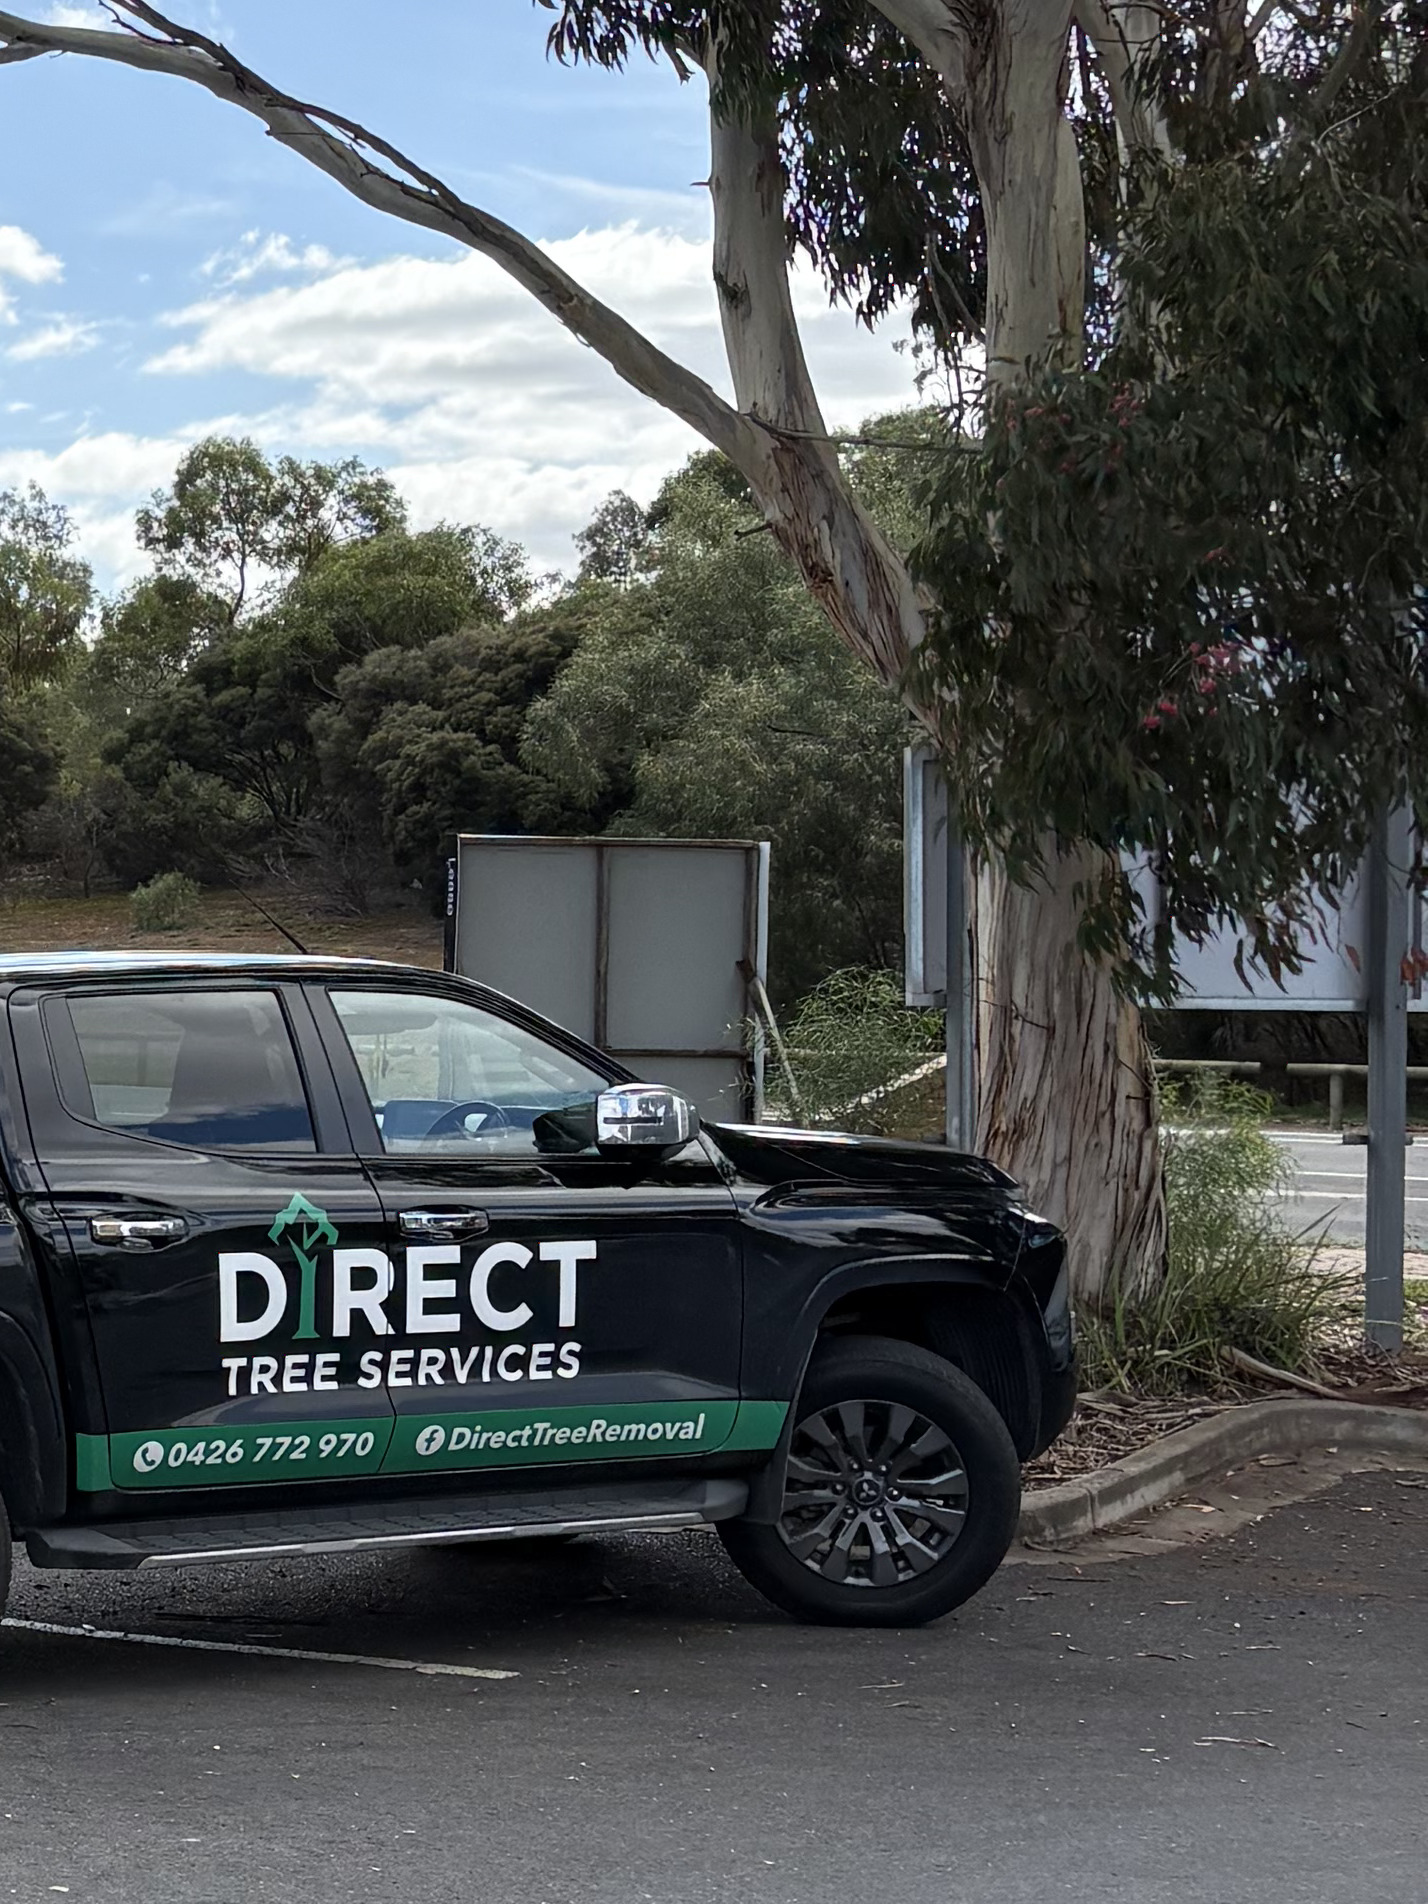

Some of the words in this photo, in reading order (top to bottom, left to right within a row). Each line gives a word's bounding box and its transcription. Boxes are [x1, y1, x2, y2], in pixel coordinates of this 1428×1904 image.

[217, 1238, 598, 1344] DIRECT
[220, 1351, 342, 1396] TREE
[356, 1340, 583, 1390] SERVICES
[167, 1438, 245, 1468] 0426
[251, 1434, 312, 1463] 772
[317, 1431, 376, 1459] 970
[447, 1412, 707, 1451] DirectTreeRemoval
